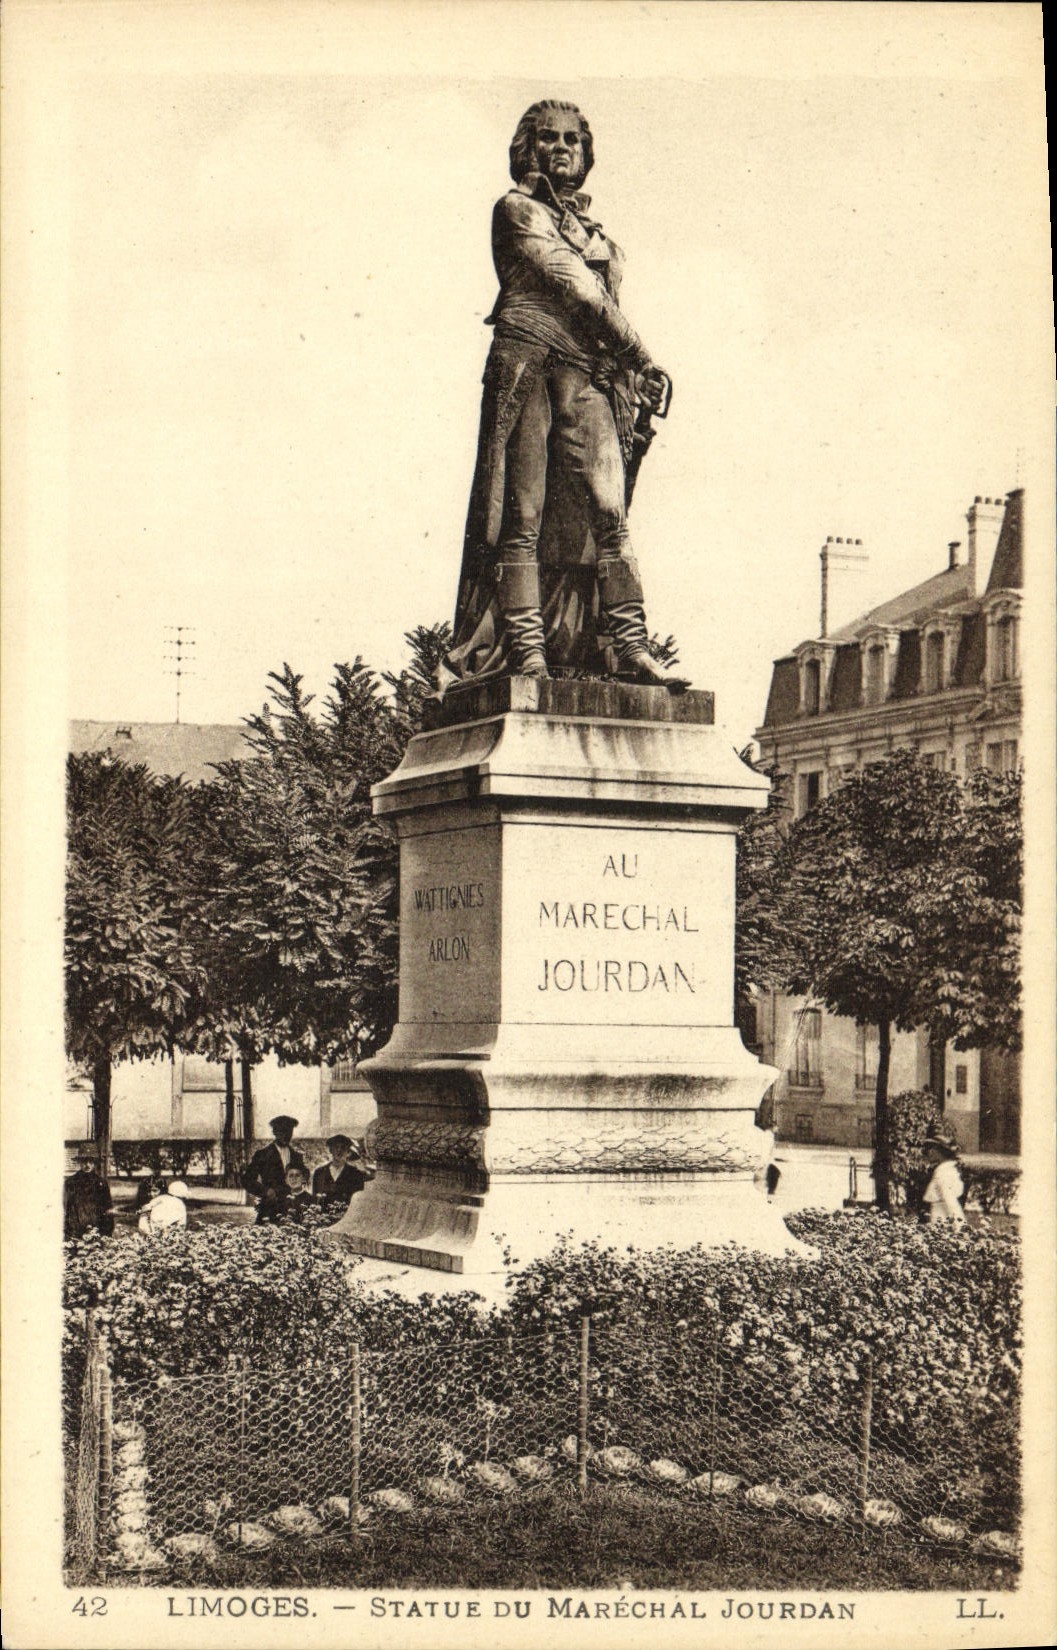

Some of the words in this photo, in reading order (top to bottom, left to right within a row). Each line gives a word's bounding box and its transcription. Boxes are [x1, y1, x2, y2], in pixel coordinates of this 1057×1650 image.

[602, 853, 638, 879] AU
[414, 882, 485, 912] WATTIGNIES
[538, 901, 700, 933] MARECHAL
[428, 935, 471, 962] ARLON
[537, 959, 697, 994] JOURDAN
